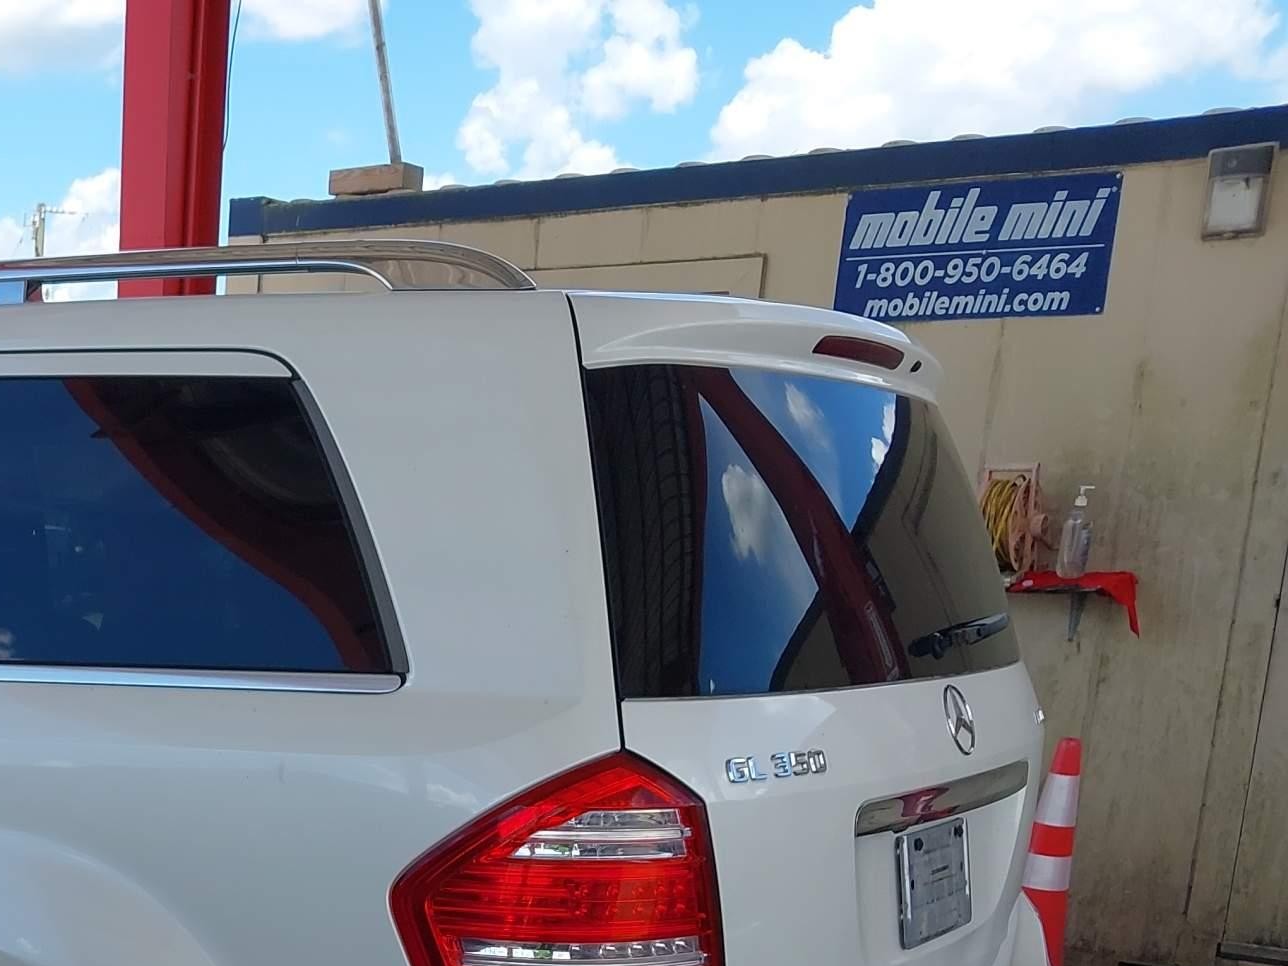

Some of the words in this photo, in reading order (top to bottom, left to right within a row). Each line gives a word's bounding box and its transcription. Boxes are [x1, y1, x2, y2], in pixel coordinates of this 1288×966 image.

[850, 188, 998, 250] mobile
[999, 188, 1111, 241] mini
[855, 252, 1087, 289] 1-800-950-6464
[863, 288, 1070, 318] mobilemini.com
[725, 755, 768, 783] GL
[770, 748, 827, 778] 350
